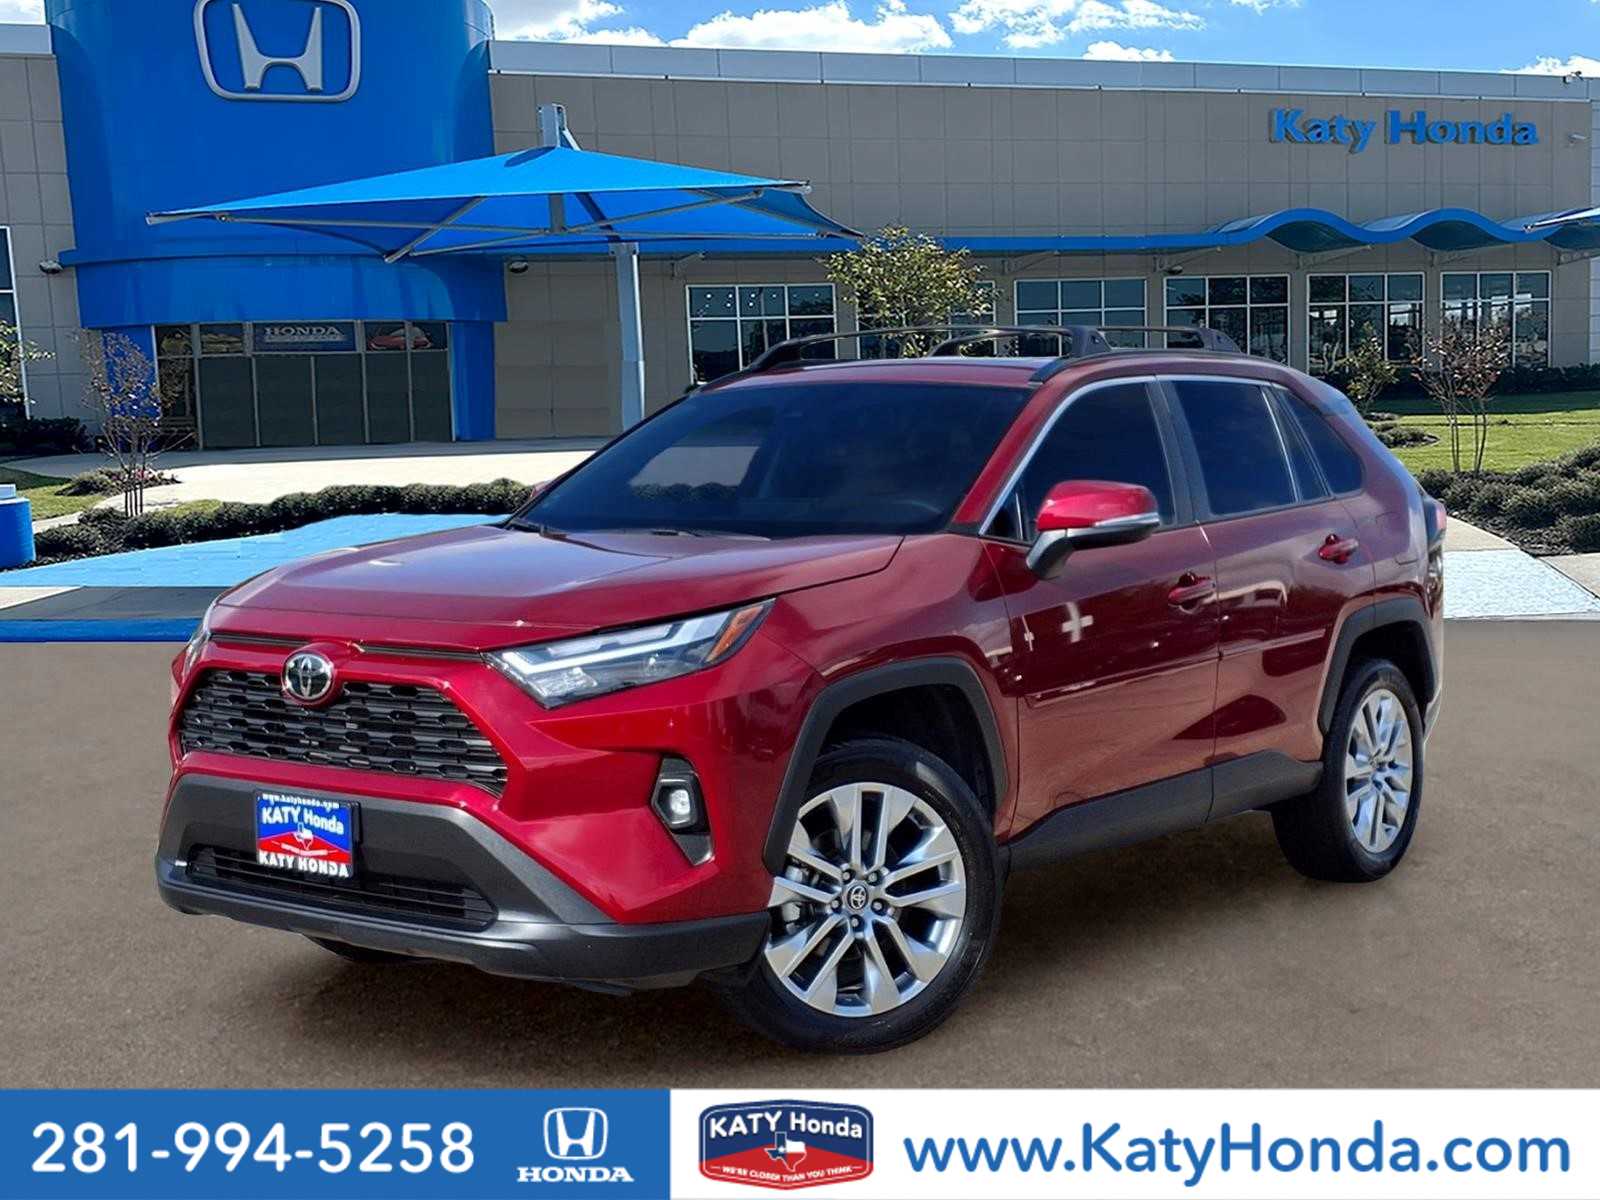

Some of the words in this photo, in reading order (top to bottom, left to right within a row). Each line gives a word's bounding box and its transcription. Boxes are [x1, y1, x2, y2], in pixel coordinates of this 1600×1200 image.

[1269, 108, 1376, 154] Katy
[1384, 108, 1539, 145] Honda
[264, 326, 345, 336] HONDA
[262, 806, 301, 824] KATY
[303, 808, 345, 835] Honda
[259, 850, 295, 869] KATY
[298, 856, 349, 877] HONDA
